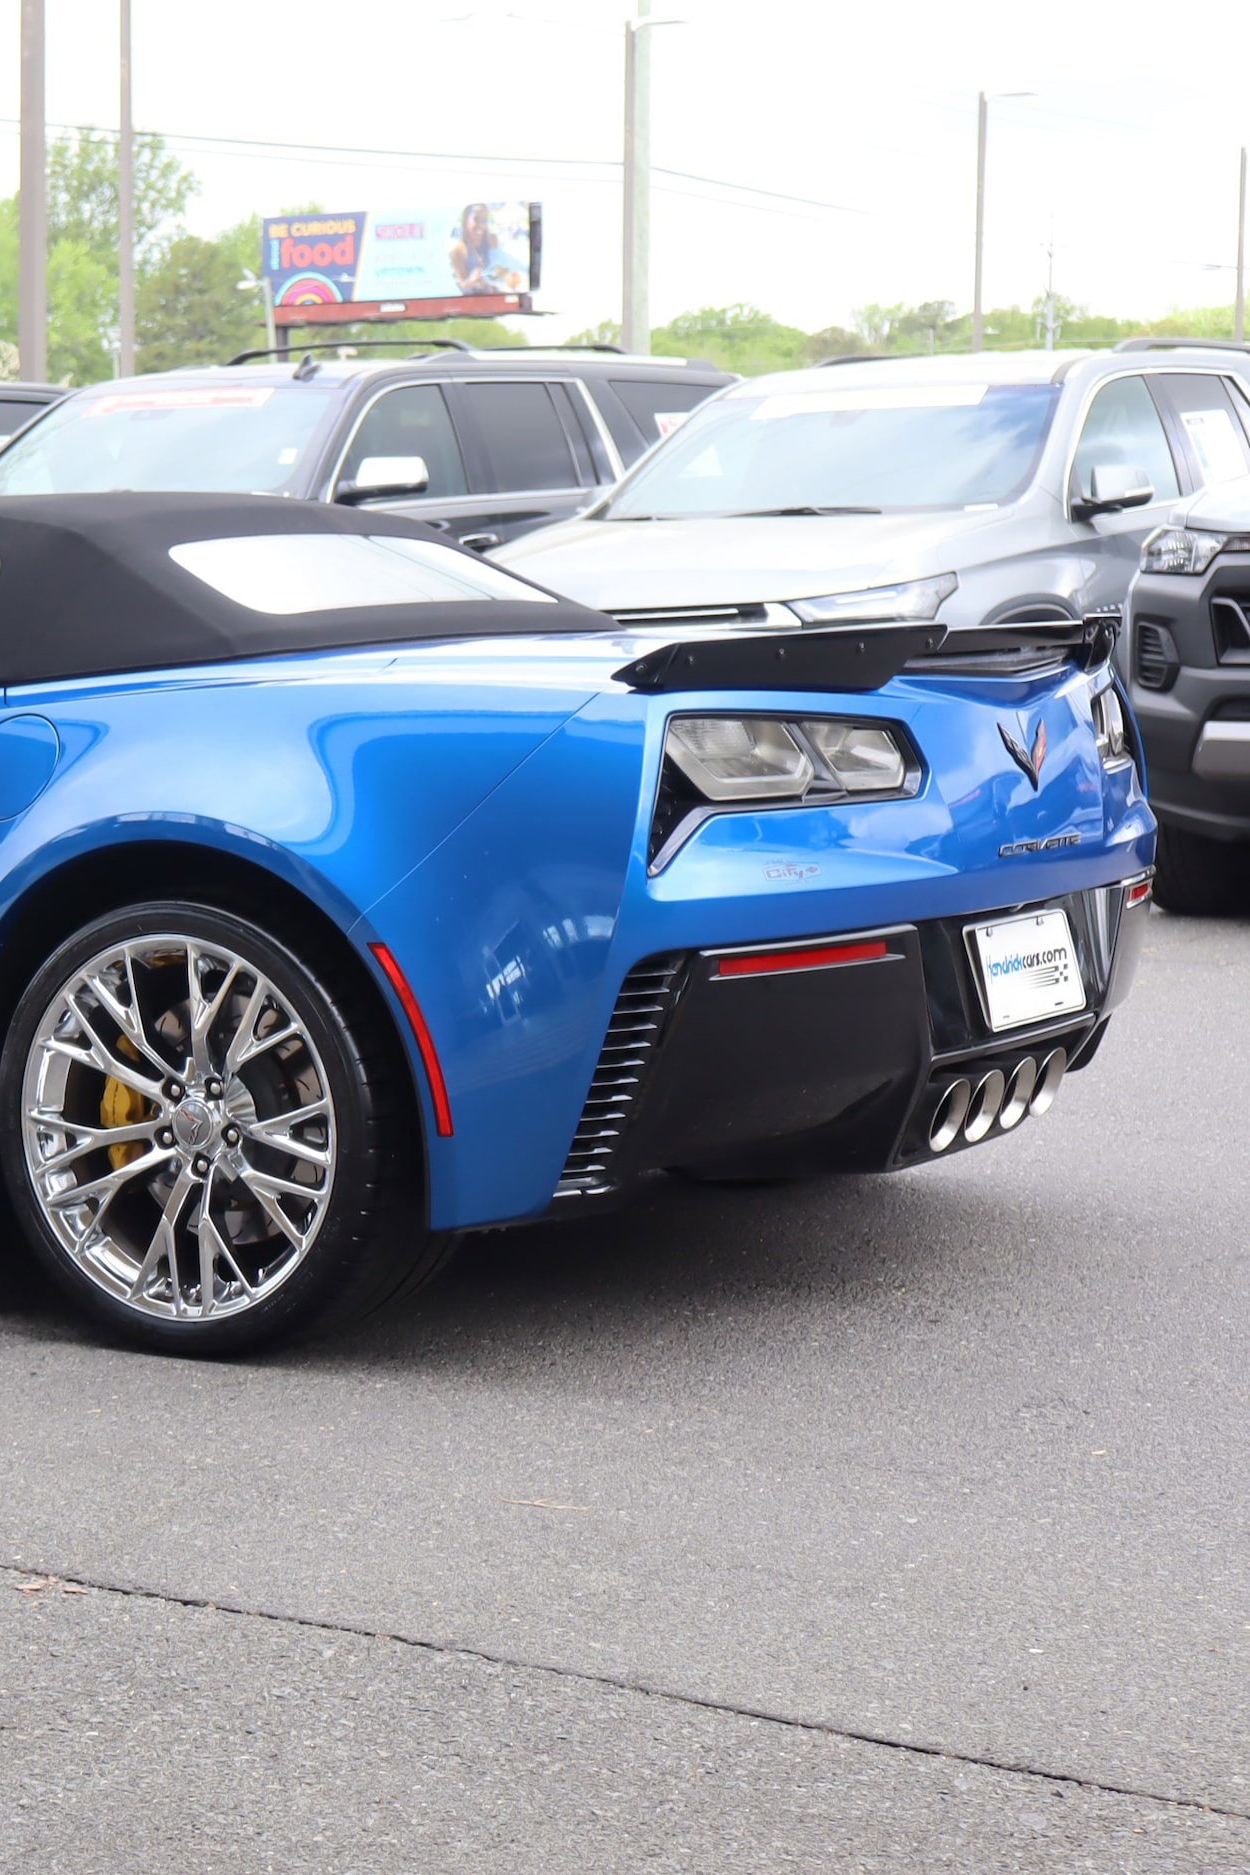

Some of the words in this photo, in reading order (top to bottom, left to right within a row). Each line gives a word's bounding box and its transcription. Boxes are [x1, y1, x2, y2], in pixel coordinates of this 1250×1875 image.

[269, 223, 289, 238] BE
[291, 219, 357, 236] CURIOUS
[281, 235, 355, 268] food
[998, 832, 1082, 857] CORVETTE
